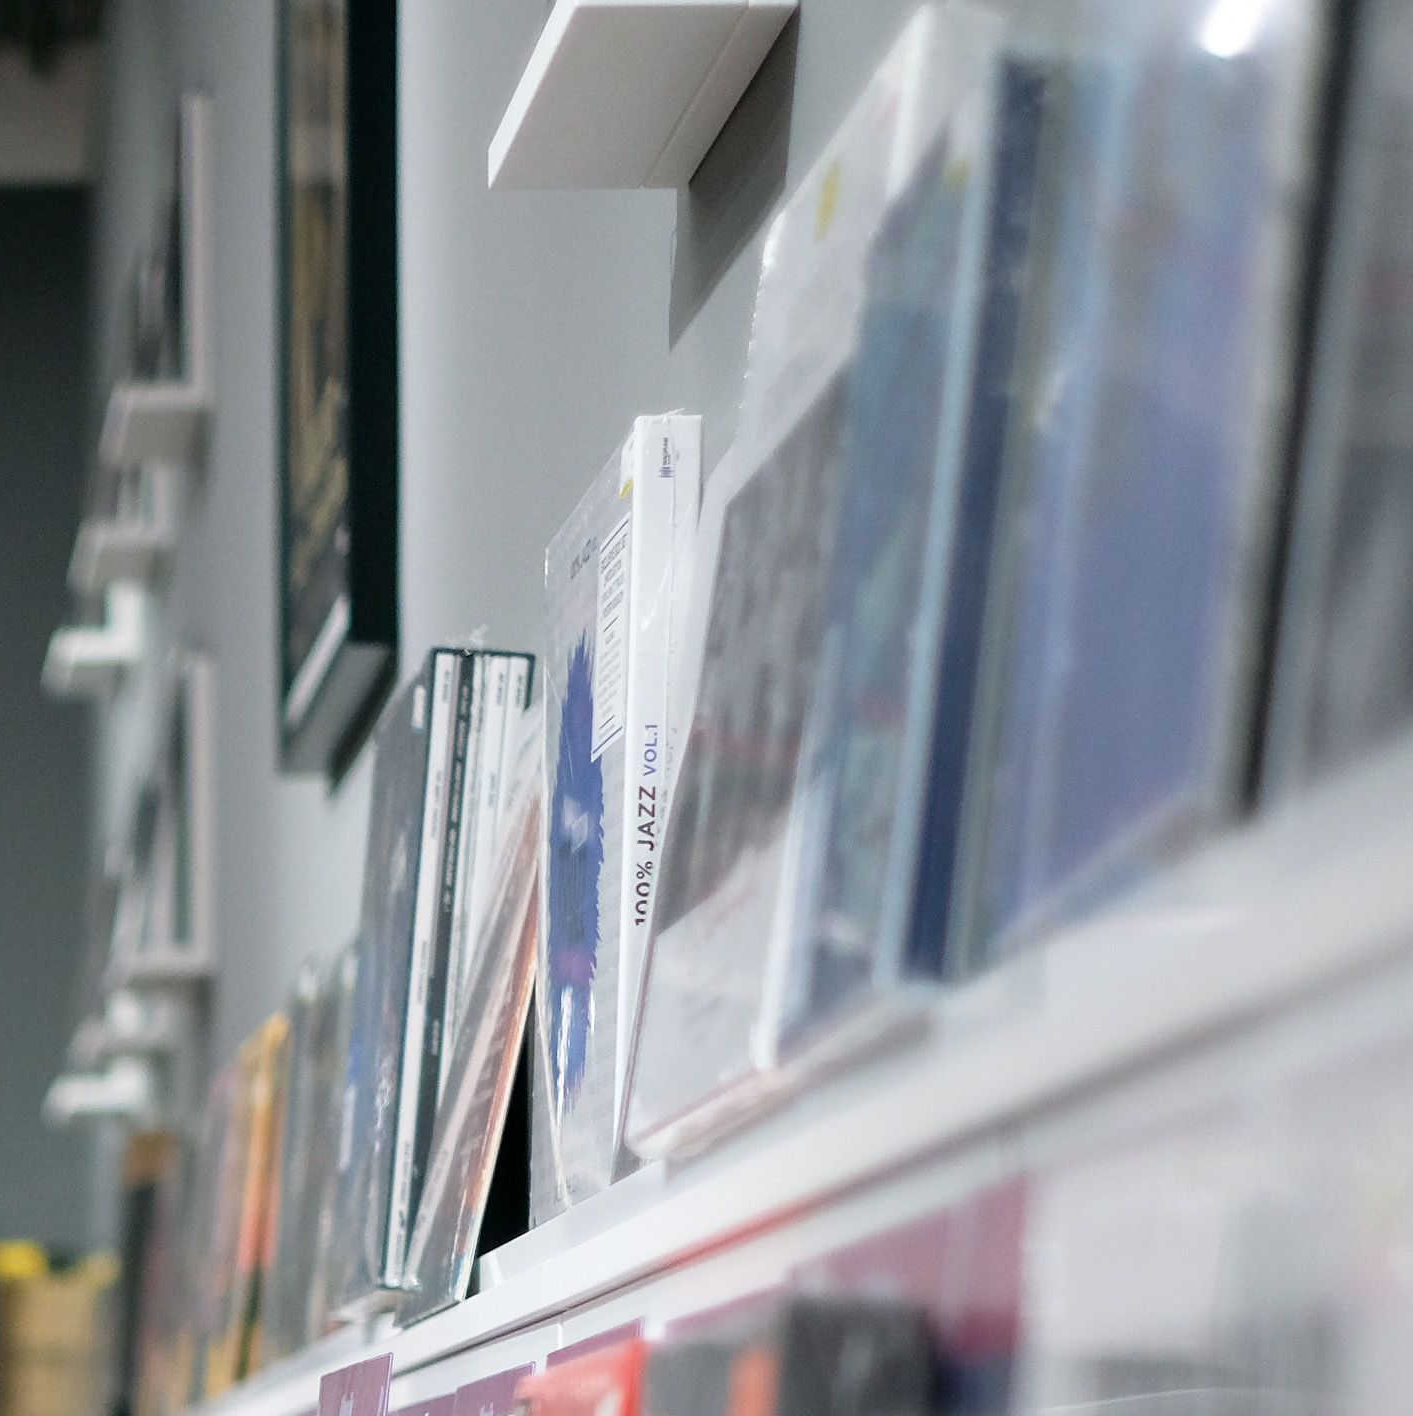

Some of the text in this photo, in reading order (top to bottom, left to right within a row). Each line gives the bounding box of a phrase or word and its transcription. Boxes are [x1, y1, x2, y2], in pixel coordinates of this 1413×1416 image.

[634, 724, 658, 926] 100% JAZZ VOL.1
